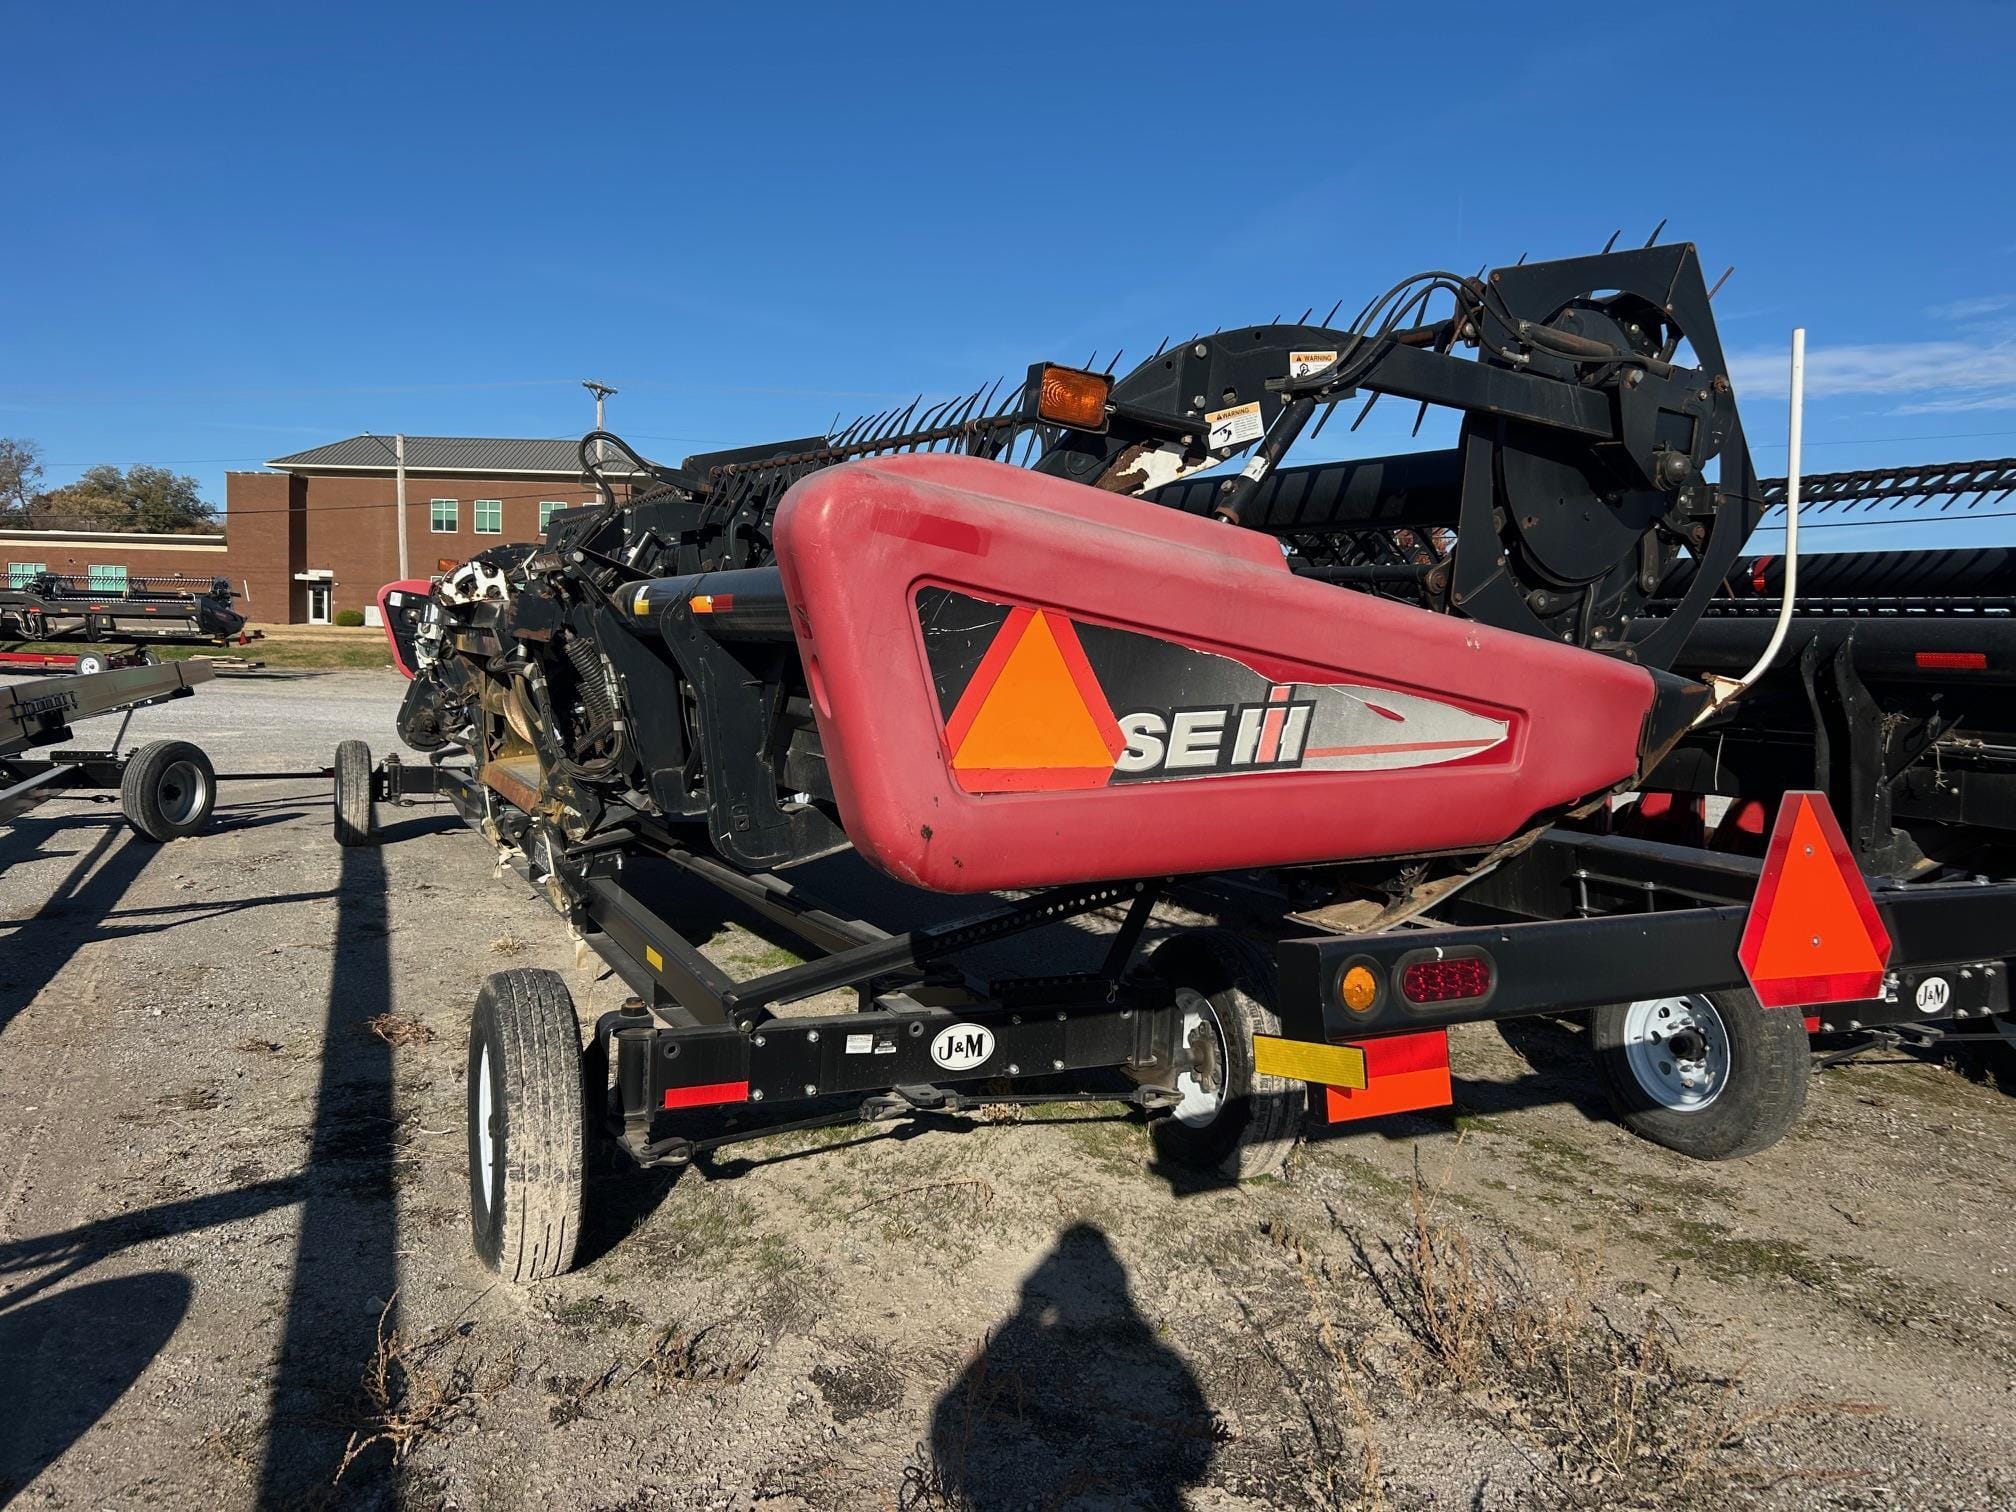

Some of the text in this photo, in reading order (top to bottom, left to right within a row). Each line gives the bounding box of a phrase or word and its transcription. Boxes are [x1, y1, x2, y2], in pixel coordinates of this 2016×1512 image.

[1222, 407, 1250, 419] WARNING
[1918, 984, 1945, 1007] J&M
[938, 1032, 984, 1061] J&M
